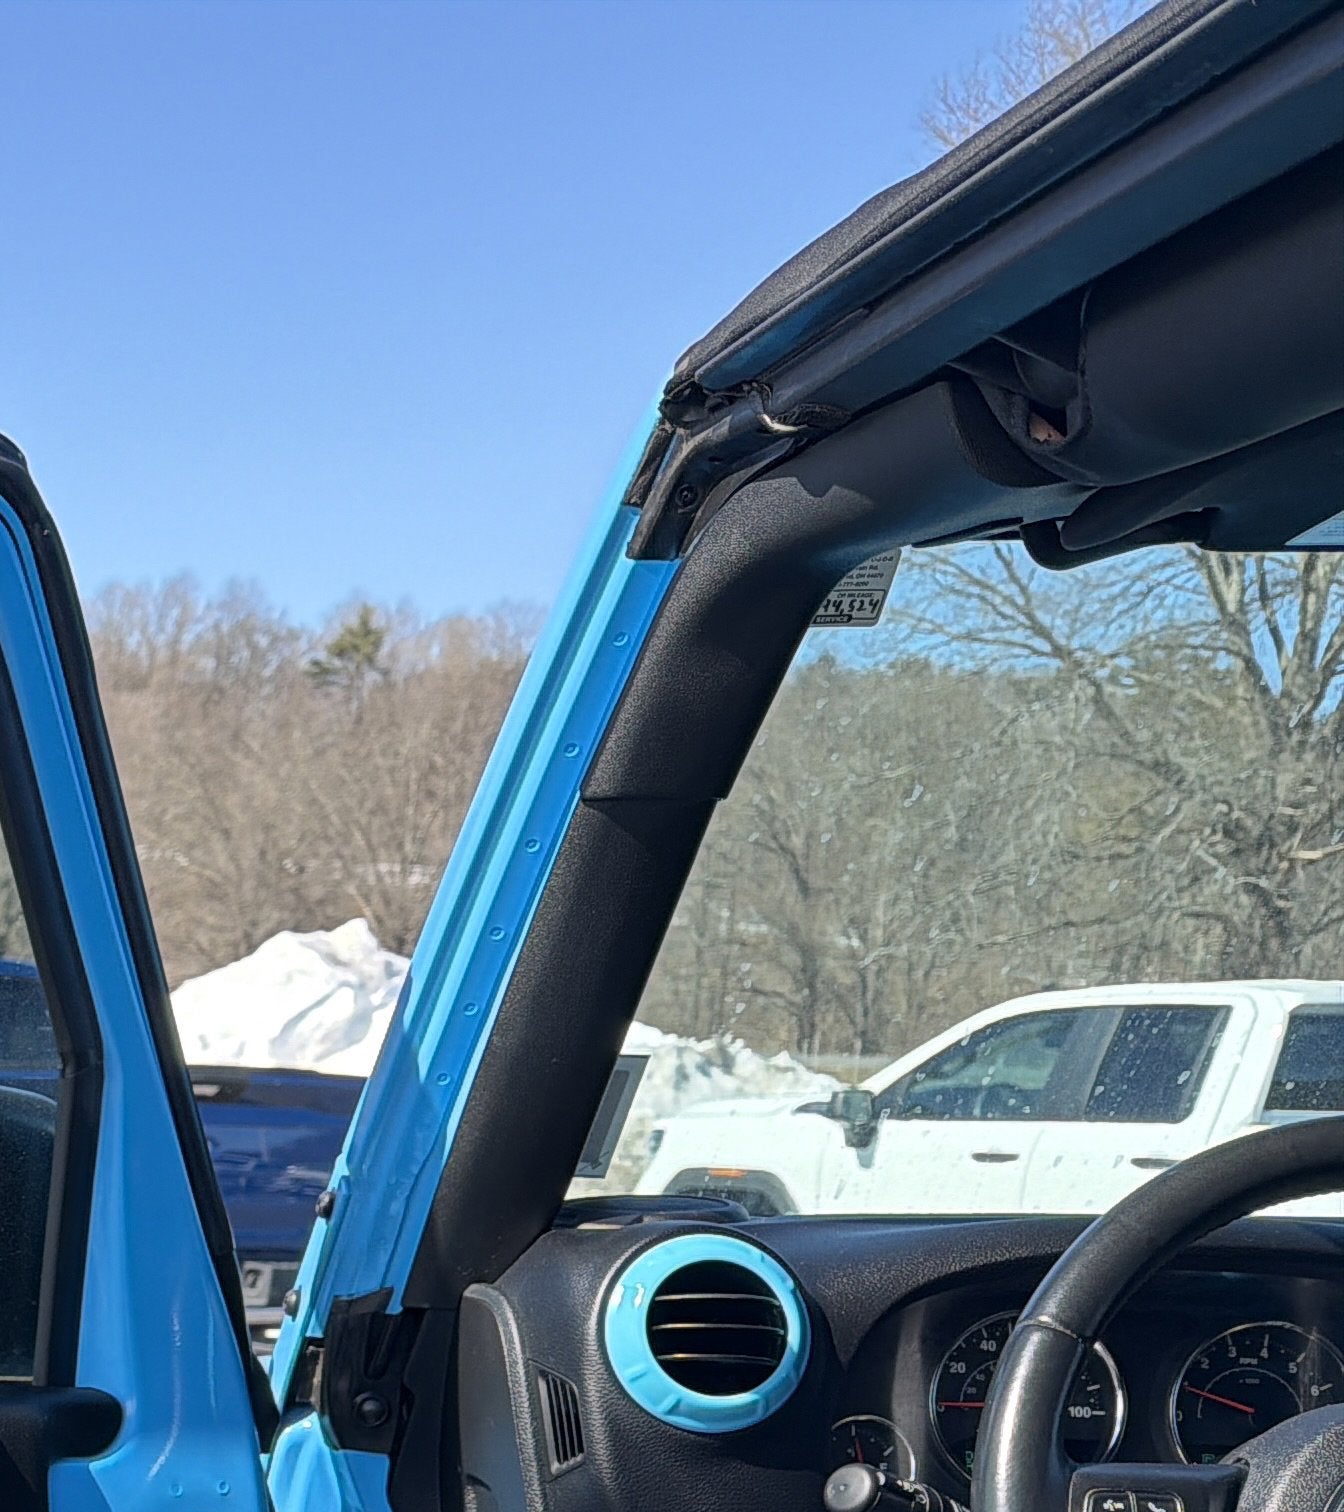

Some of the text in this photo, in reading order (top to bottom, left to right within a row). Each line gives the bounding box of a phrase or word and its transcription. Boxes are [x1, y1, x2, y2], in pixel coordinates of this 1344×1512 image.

[815, 616, 850, 624] SERVICE
[980, 1340, 996, 1351] 40
[1228, 1346, 1237, 1358] 3
[1260, 1348, 1269, 1359] 4
[949, 1362, 966, 1373] 20
[1200, 1358, 1210, 1369] 2
[1288, 1362, 1297, 1373] 5
[1311, 1385, 1319, 1396] 6
[1068, 1406, 1092, 1418] 100
